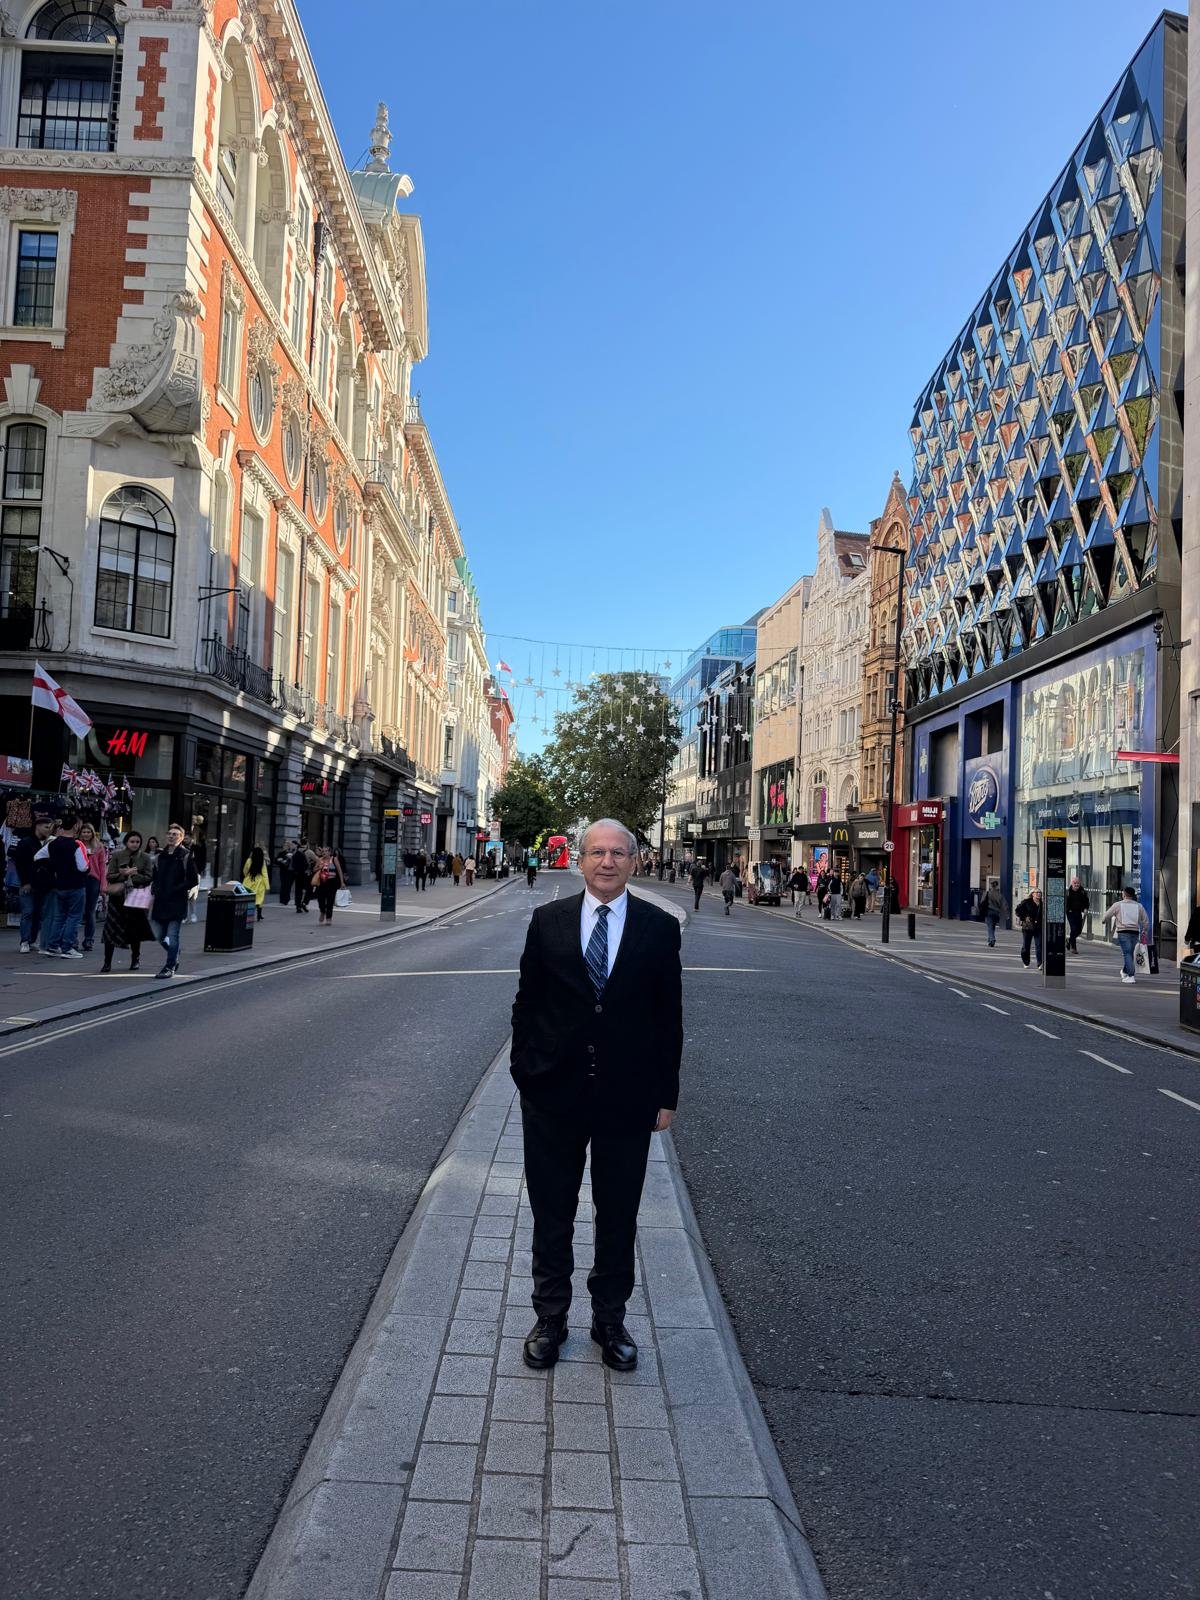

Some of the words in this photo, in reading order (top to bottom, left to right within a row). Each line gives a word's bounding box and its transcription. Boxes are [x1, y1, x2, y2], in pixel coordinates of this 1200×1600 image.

[107, 730, 148, 758] H&M
[922, 806, 938, 814] MUJI
[968, 779, 989, 813] Boots
